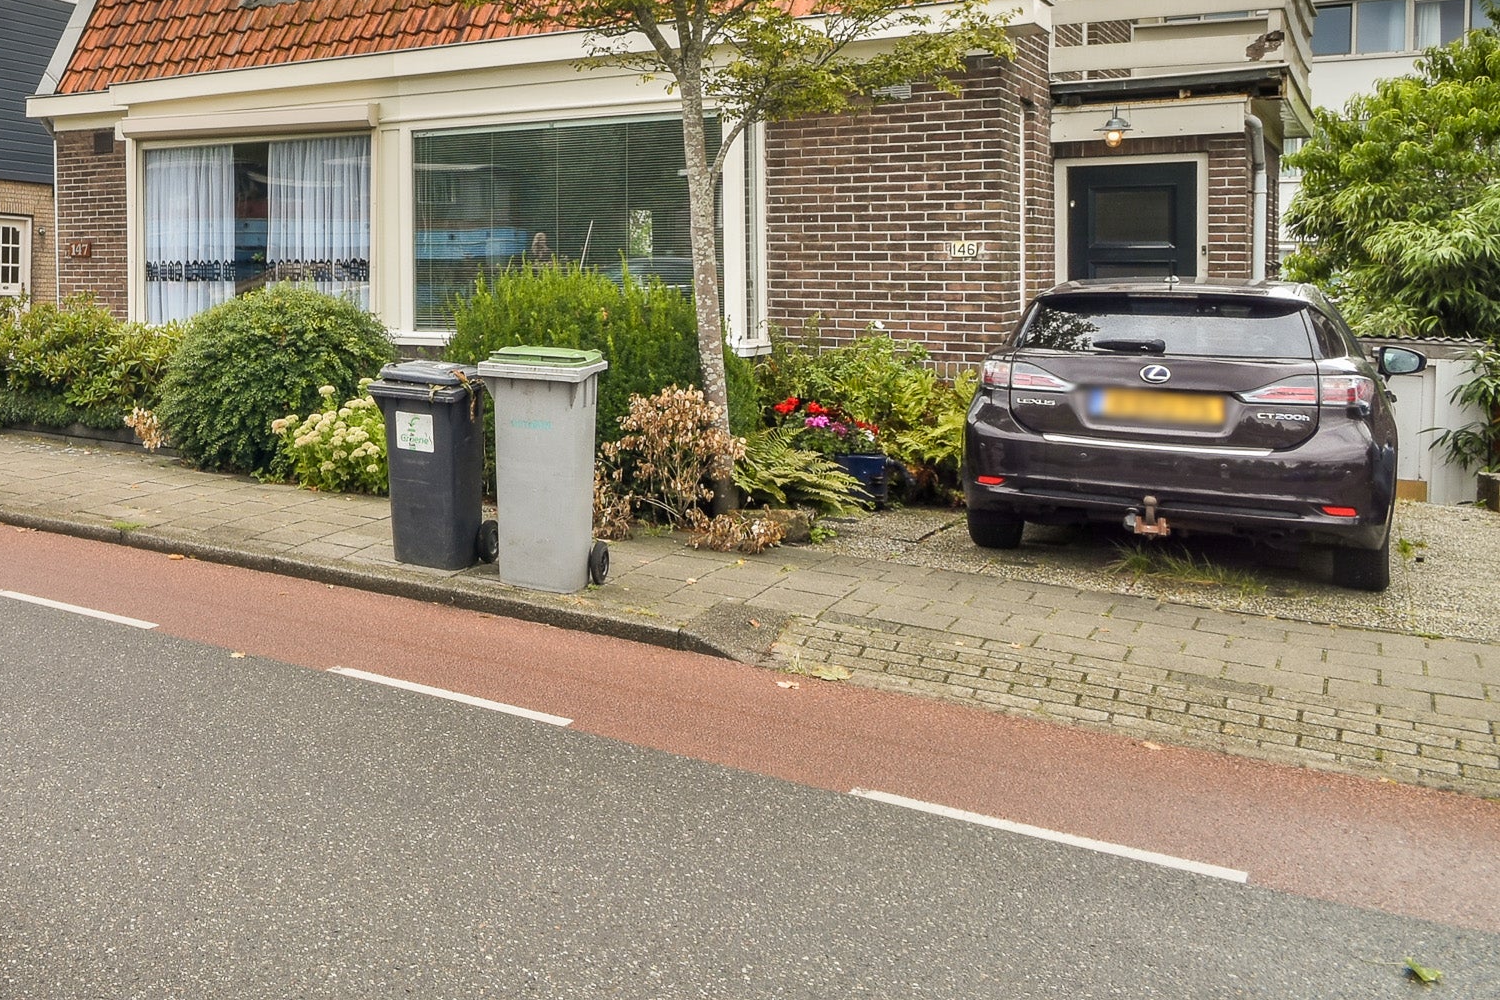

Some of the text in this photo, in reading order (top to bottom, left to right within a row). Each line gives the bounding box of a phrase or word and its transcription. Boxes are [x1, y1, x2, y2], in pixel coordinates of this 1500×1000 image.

[70, 243, 89, 256] 147
[952, 243, 976, 256] 146
[1016, 397, 1056, 406] LEXUS
[1256, 412, 1310, 422] CT200h
